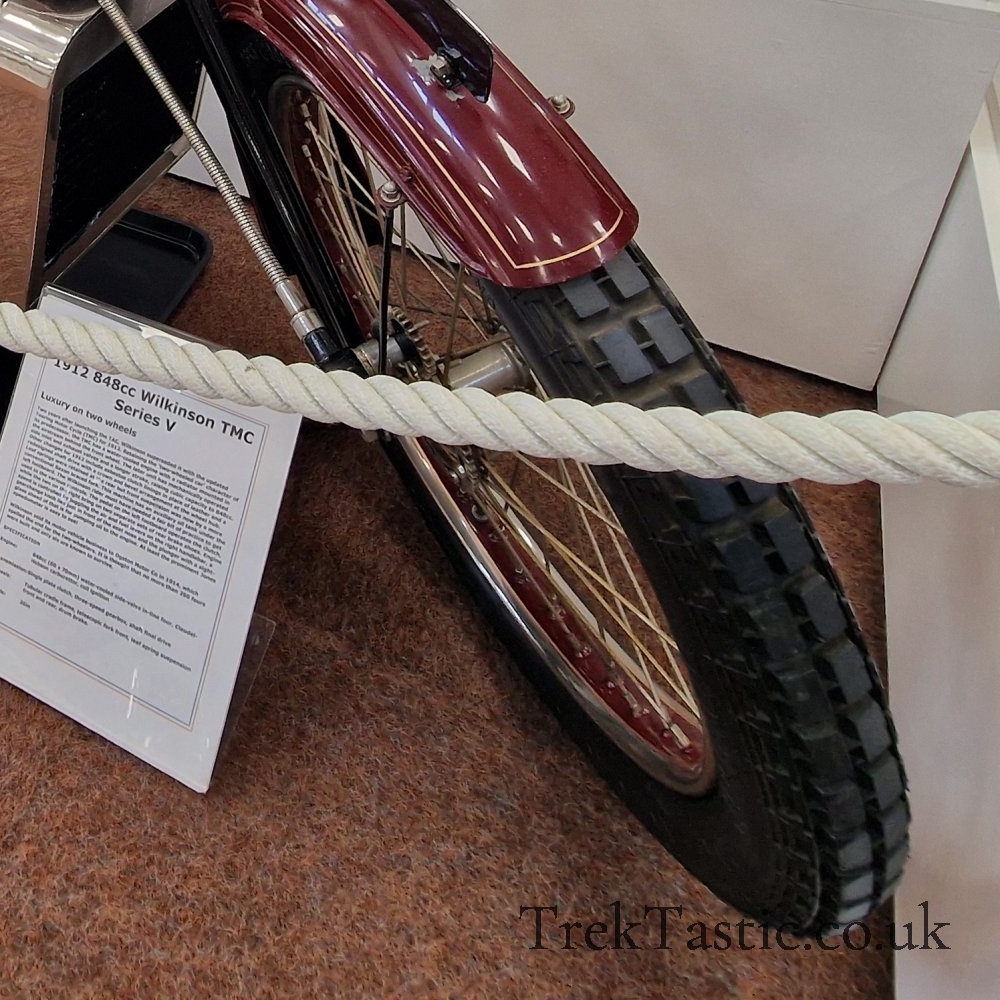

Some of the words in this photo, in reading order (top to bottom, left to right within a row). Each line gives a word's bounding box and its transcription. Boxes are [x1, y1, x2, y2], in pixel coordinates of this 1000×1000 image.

[39, 390, 70, 411] Luxury
[72, 405, 83, 415] on
[85, 410, 103, 423] two
[104, 417, 137, 437] wheels
[53, 359, 89, 379] 1912
[92, 370, 137, 398] 848cc
[139, 388, 216, 429] Wilkinson
[218, 420, 255, 445] TMC
[113, 397, 161, 427] Series
[164, 418, 176, 433] V
[82, 431, 98, 442] (TMC)
